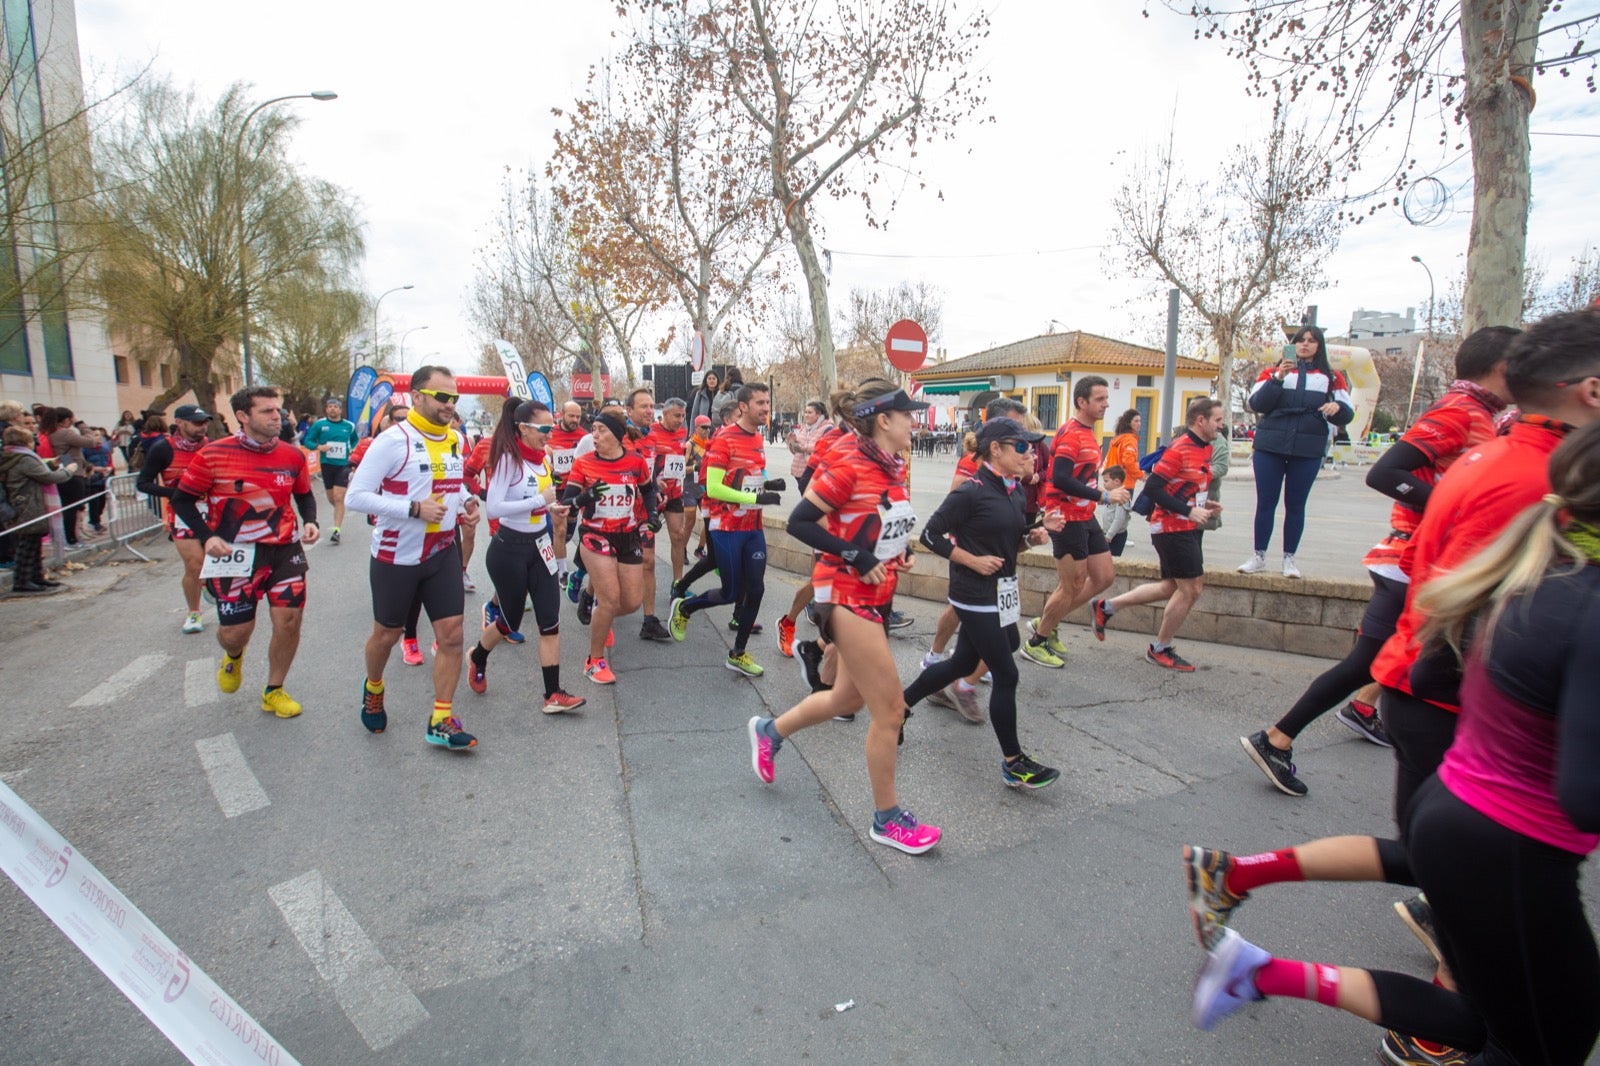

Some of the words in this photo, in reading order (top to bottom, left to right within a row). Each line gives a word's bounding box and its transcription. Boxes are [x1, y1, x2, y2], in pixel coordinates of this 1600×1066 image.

[557, 455, 574, 465] 837
[669, 461, 684, 471] 179
[599, 494, 633, 507] 2129
[881, 516, 917, 541] 2206
